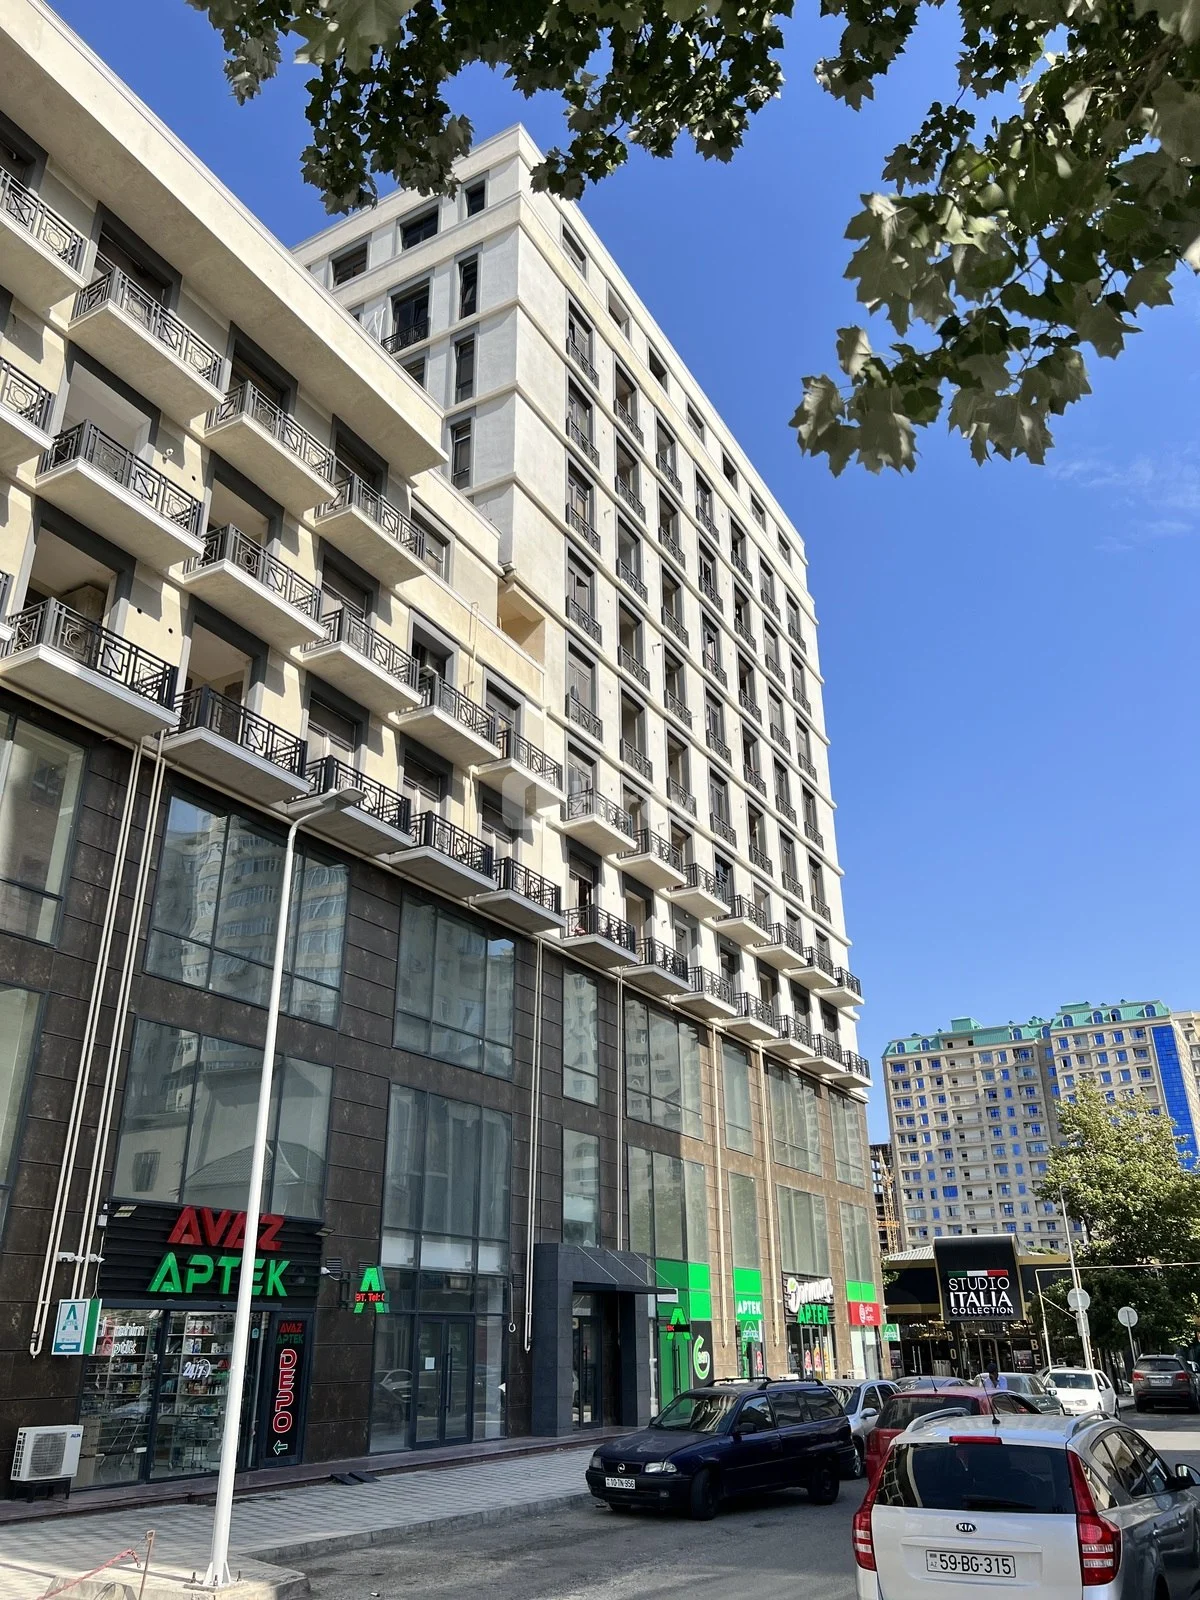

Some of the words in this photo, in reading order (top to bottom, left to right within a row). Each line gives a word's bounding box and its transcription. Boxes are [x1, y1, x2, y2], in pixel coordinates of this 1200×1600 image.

[167, 1206, 285, 1251] AVAZ
[147, 1251, 291, 1297] APTEK
[949, 1277, 1010, 1291] STUDIO
[738, 1300, 761, 1314] APTEK
[950, 1291, 1013, 1307] ITALIA
[797, 1304, 829, 1324] APTEK
[951, 1307, 1014, 1315] COLLECTION
[280, 1323, 302, 1333] AVAZ
[277, 1334, 303, 1344] APTEK
[183, 1361, 204, 1379] 24/7
[273, 1349, 297, 1433] DEPO
[958, 1523, 974, 1531] KIA
[940, 1554, 1011, 1575] 59-BG-315
